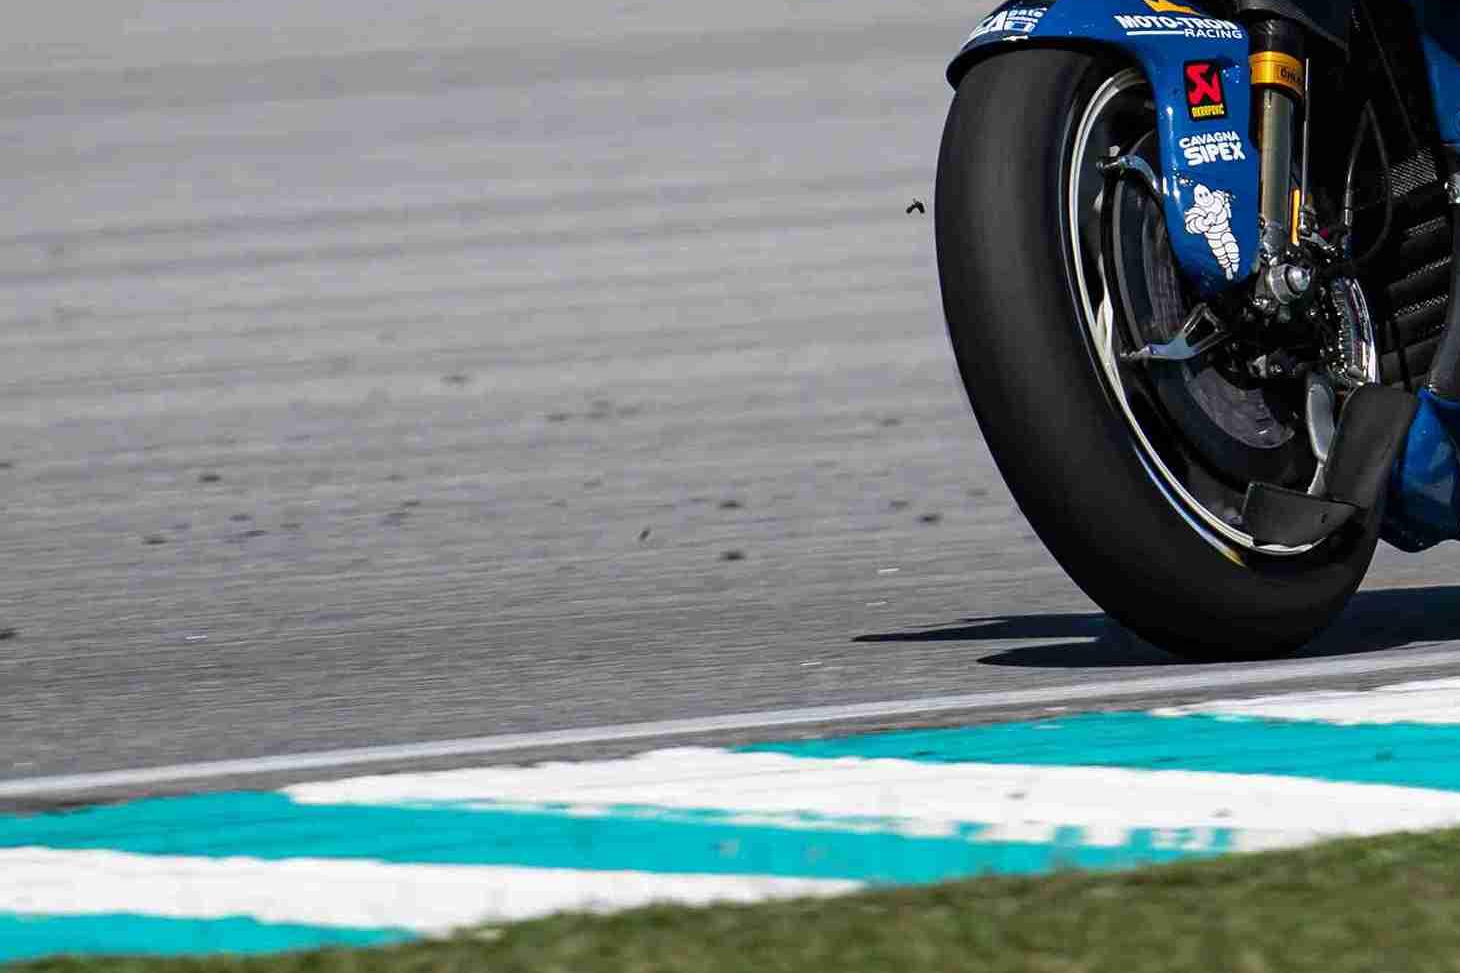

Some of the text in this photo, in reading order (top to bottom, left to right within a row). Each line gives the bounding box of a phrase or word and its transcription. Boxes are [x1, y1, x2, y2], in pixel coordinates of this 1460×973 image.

[1114, 14, 1239, 31] MOTO-TRON
[1184, 27, 1243, 40] RACING
[1179, 130, 1241, 148] CAVAGNA
[1184, 142, 1246, 167] SIPEX
